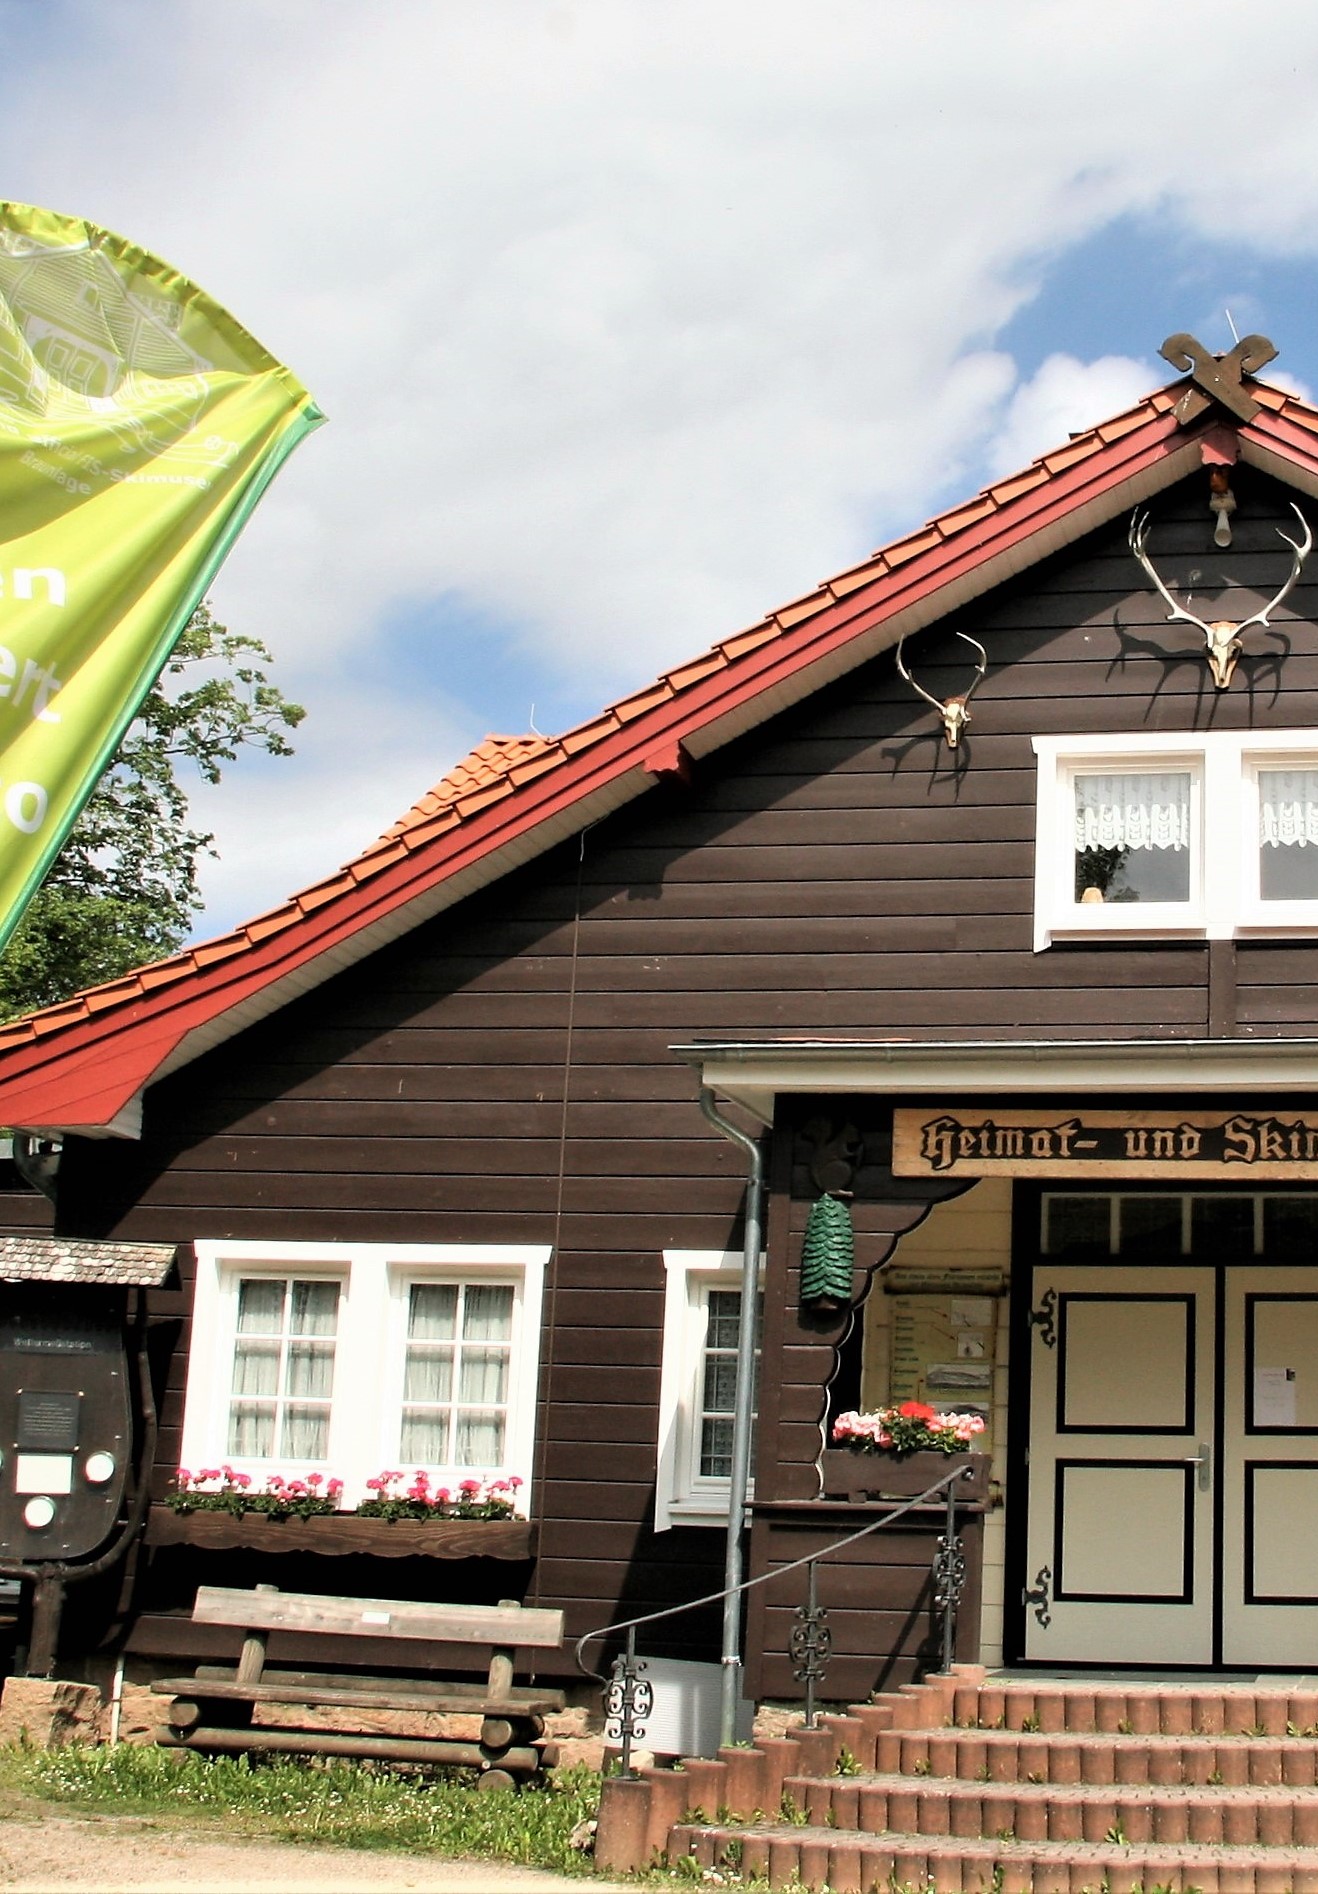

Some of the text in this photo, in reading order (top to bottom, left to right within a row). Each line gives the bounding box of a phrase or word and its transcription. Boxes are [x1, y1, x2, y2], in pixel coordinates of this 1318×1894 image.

[0, 567, 66, 607] n
[921, 1118, 1098, 1169] Heimat-
[1124, 1124, 1200, 1158] und
